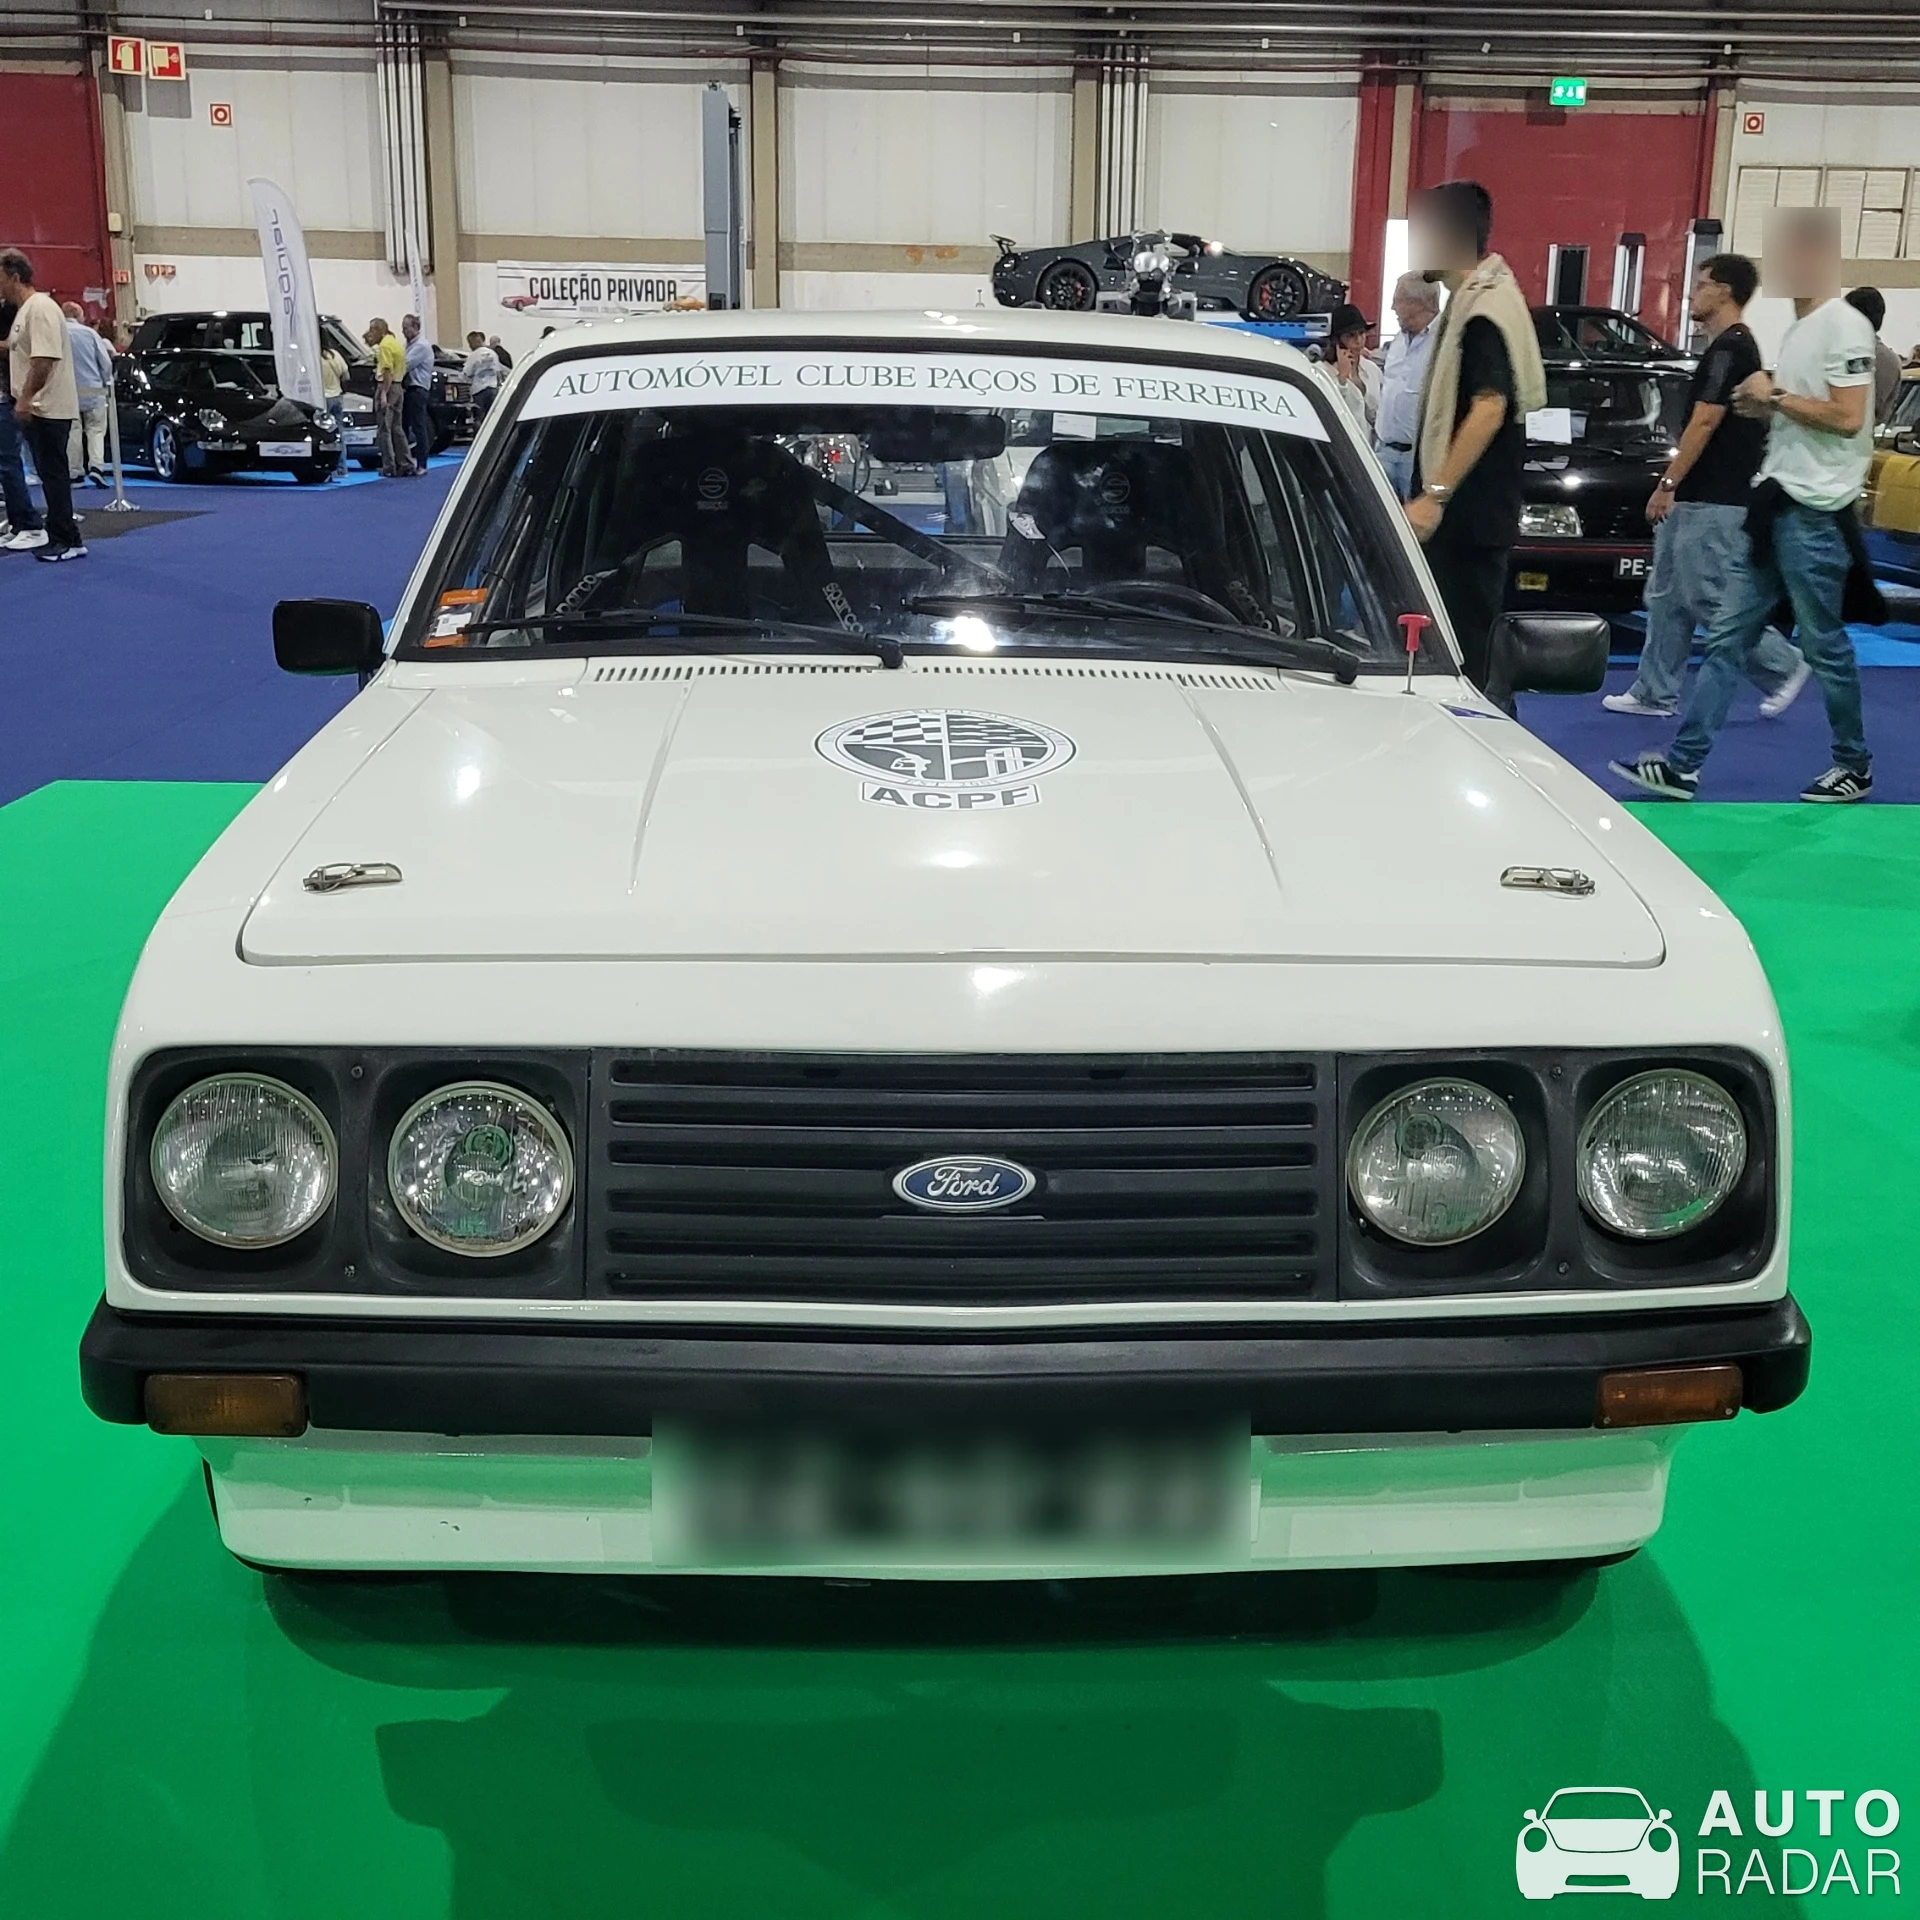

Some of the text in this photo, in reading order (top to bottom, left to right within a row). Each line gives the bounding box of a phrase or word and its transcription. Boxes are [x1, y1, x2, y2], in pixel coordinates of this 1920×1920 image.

[529, 273, 677, 305] COLEÇÃO PRIVADA
[553, 360, 1298, 418] AUTOMÓVEL CLUBE PAÇOS DE FERREIRA
[1619, 558, 1654, 576] PE-
[869, 786, 1030, 809] ACPF
[926, 1166, 1002, 1197] Ford
